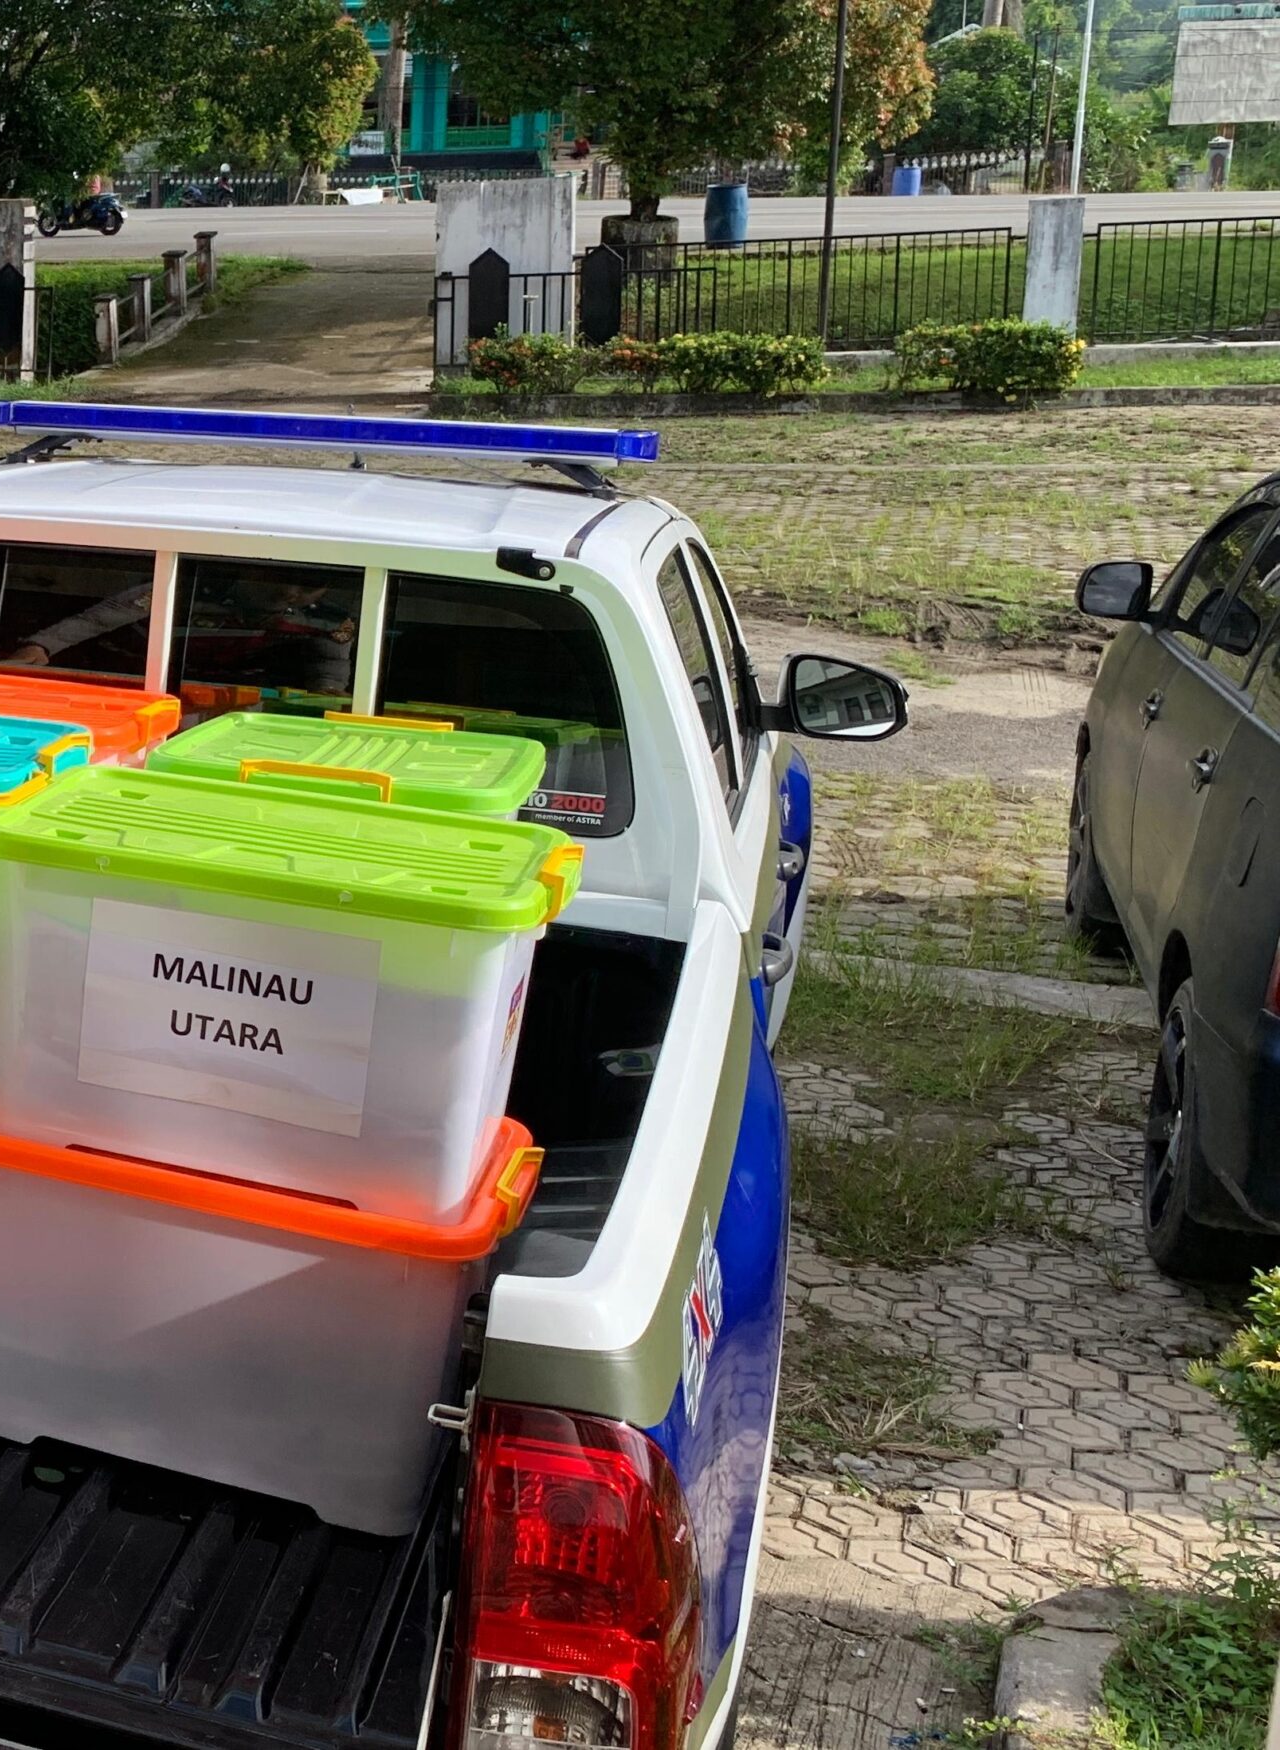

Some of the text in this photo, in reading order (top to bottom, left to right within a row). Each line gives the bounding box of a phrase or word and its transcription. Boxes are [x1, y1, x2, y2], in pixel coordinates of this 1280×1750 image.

[521, 793, 606, 813] TO 2000
[535, 813, 566, 822] member
[575, 816, 601, 825] ASTRA
[152, 953, 314, 1006] MALINAU
[170, 1009, 284, 1056] UTARA
